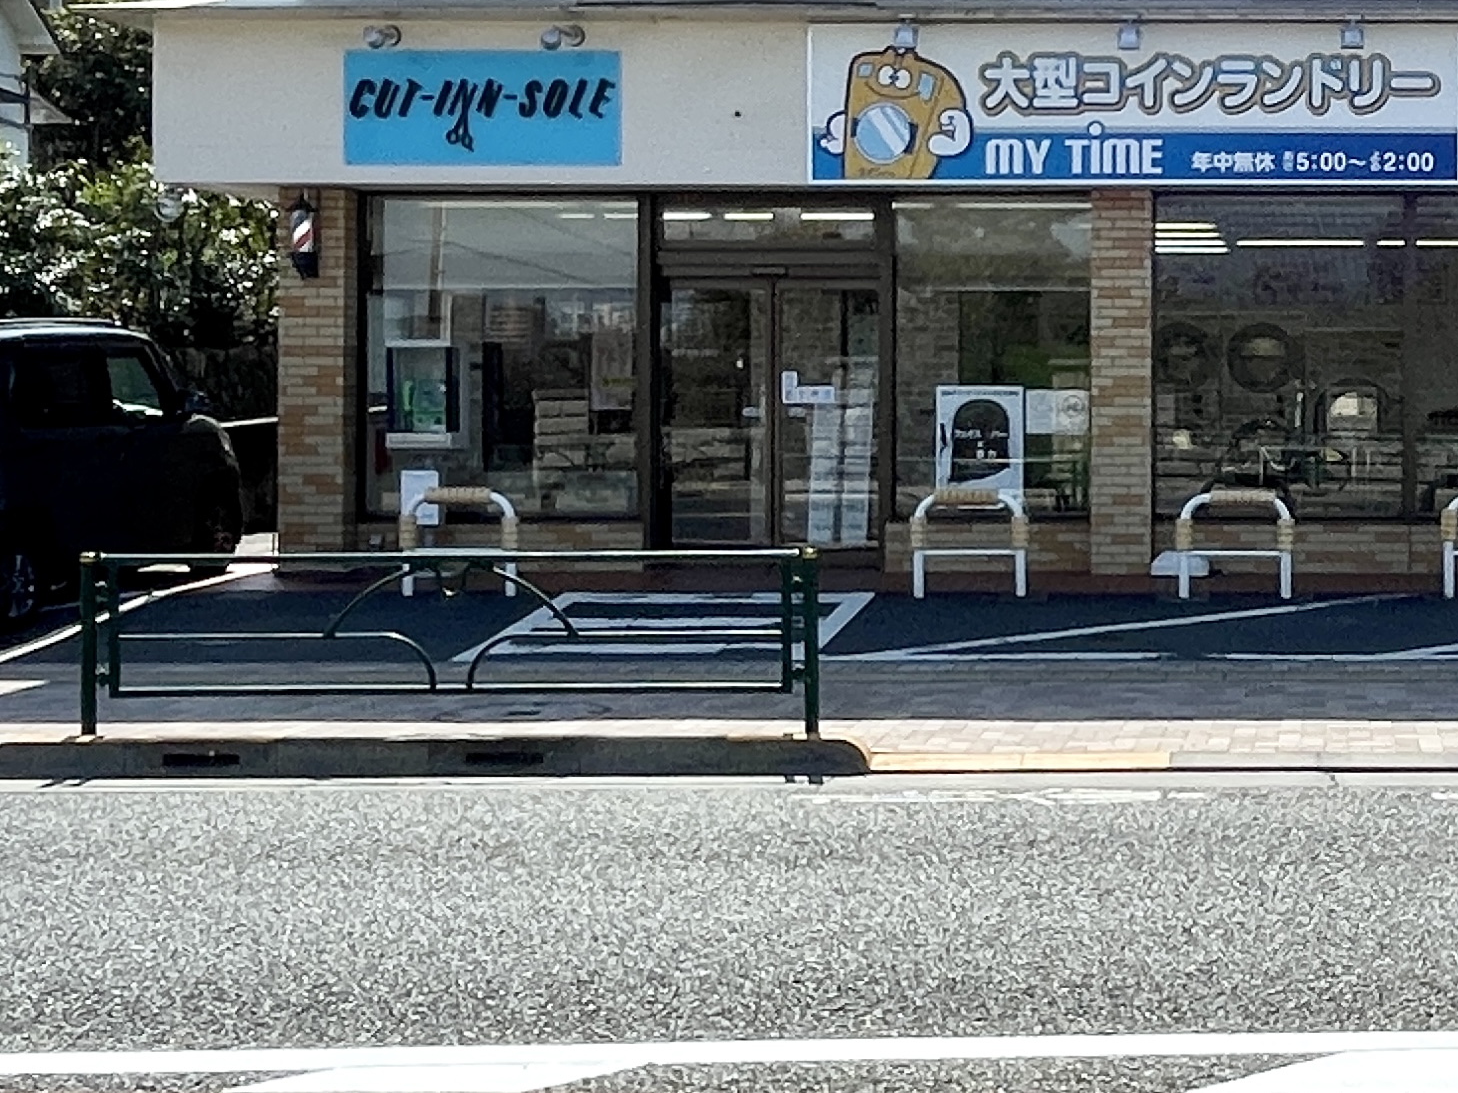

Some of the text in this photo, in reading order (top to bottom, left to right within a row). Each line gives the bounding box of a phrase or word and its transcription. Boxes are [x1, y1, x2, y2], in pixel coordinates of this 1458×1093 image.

[981, 50, 1441, 115] 大型コインランドリー
[985, 138, 1051, 174] MY
[1191, 151, 1276, 173] 年中無休
